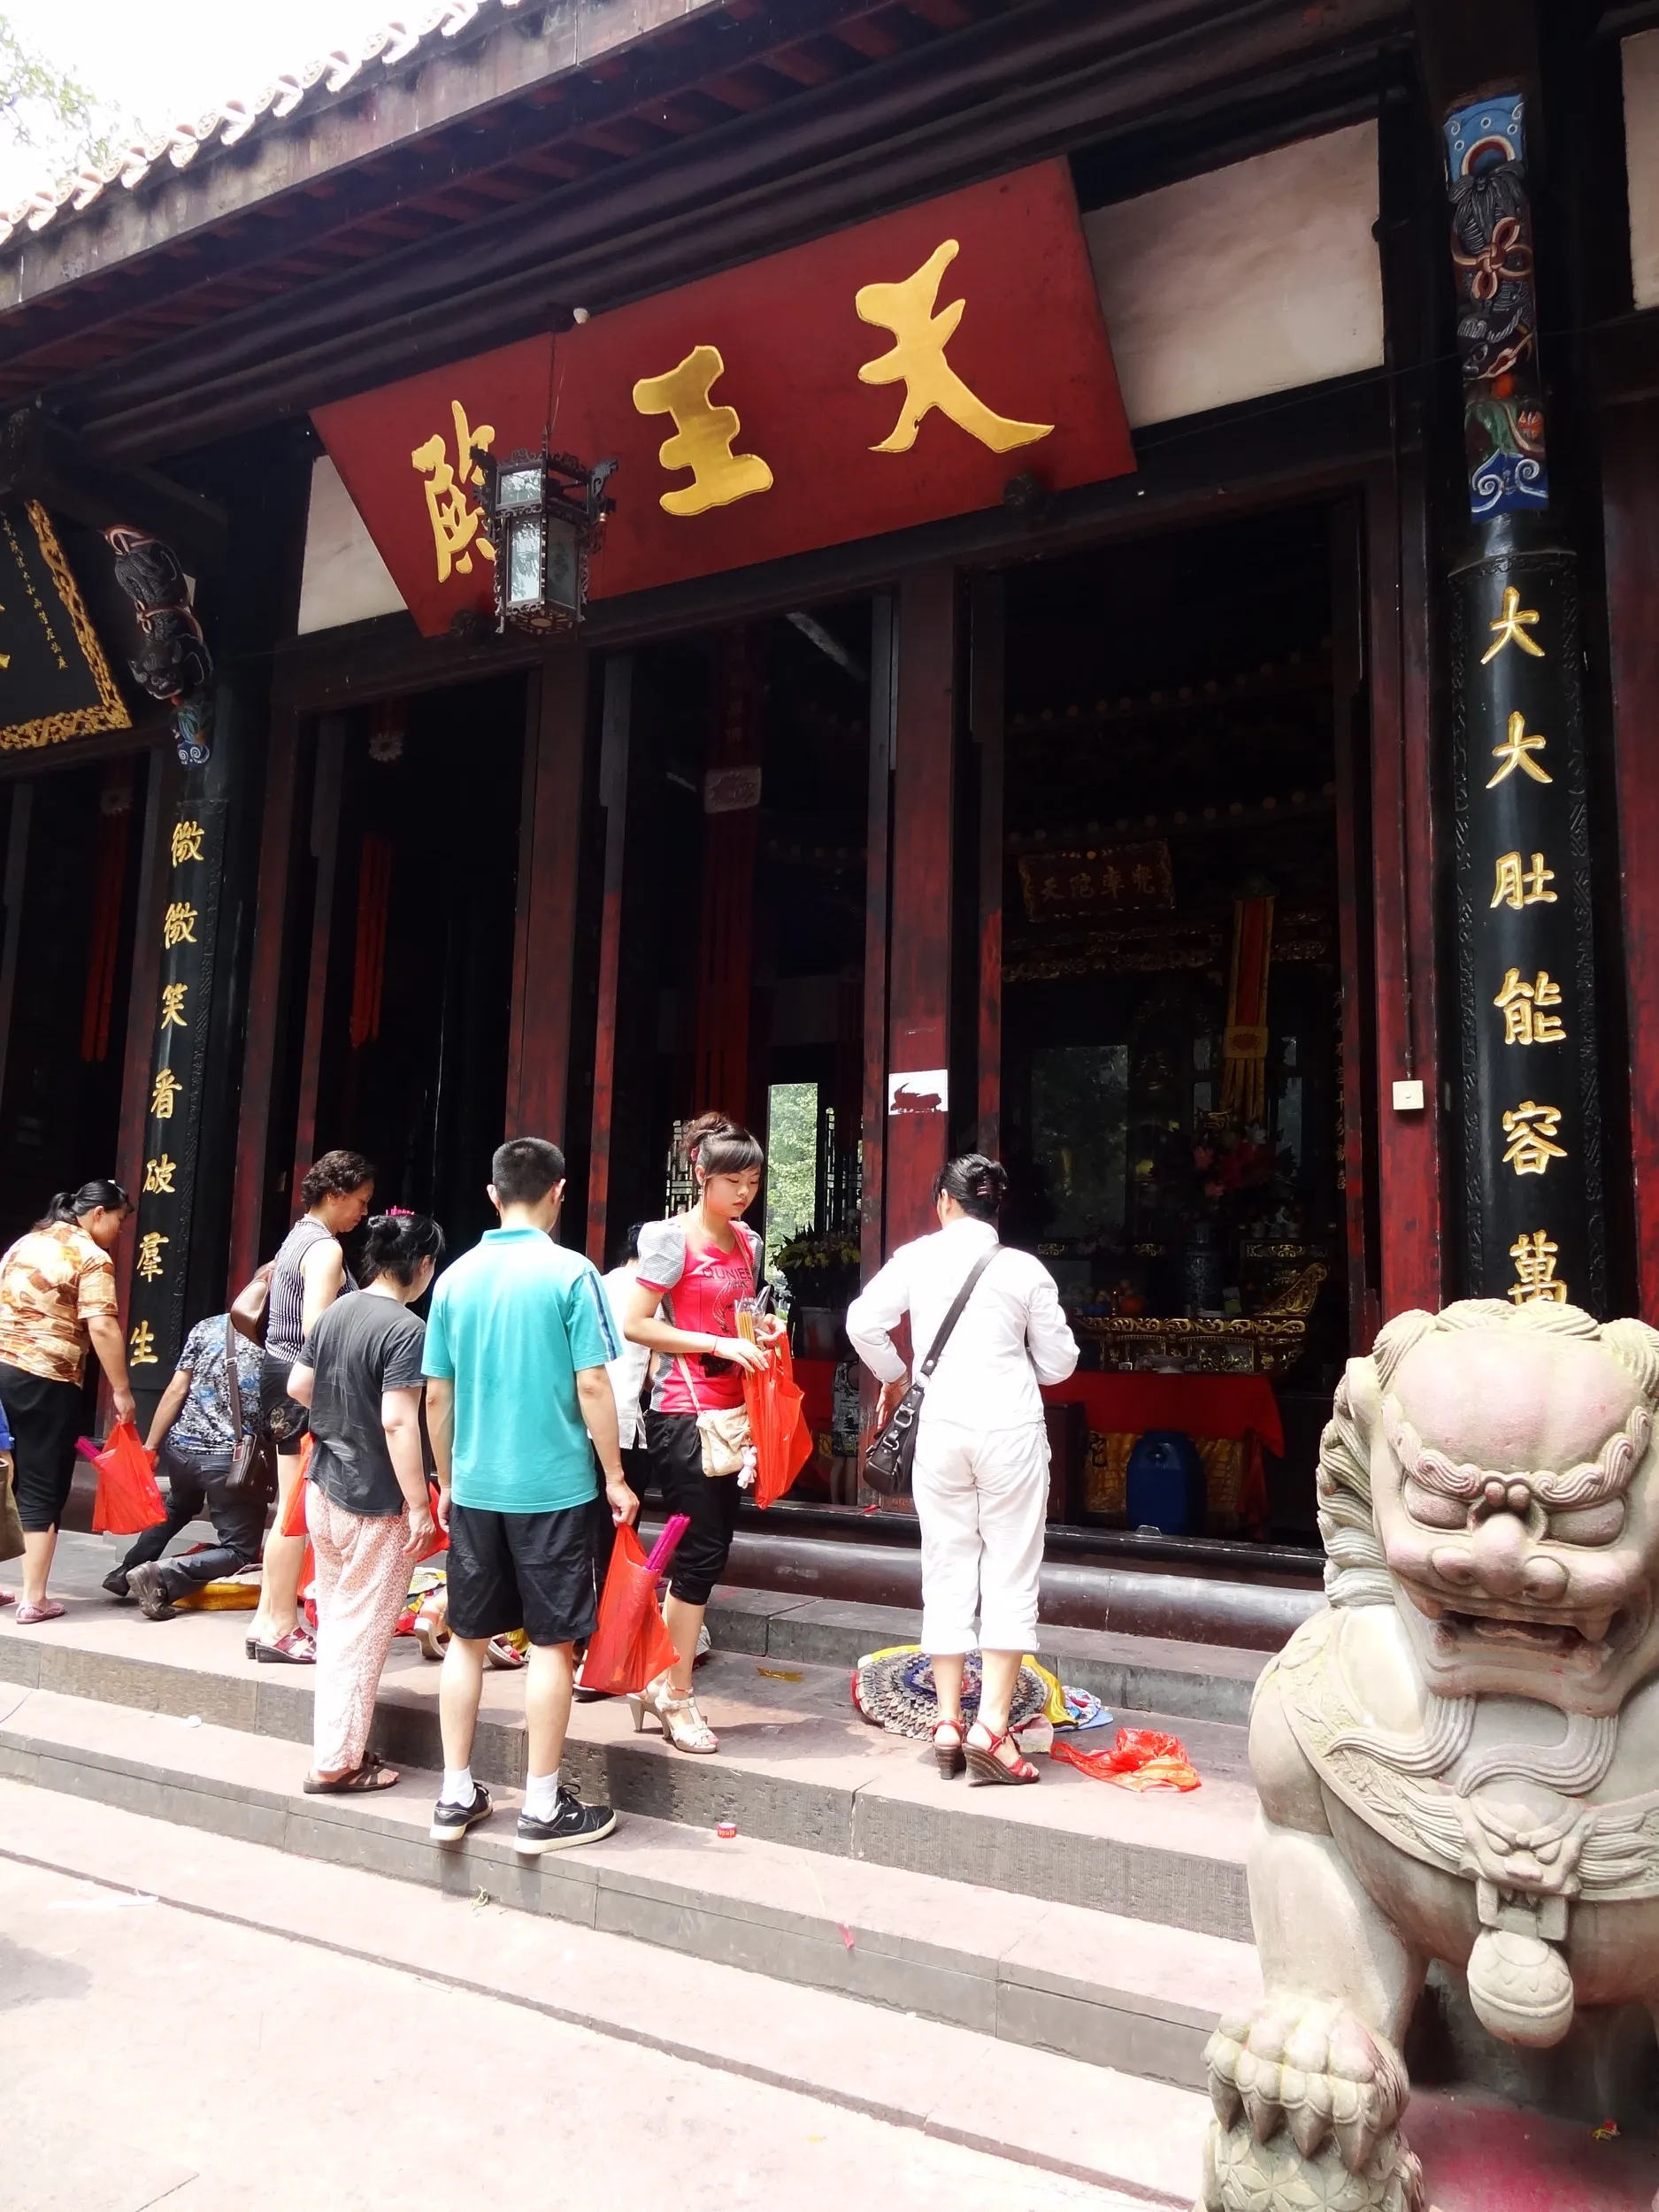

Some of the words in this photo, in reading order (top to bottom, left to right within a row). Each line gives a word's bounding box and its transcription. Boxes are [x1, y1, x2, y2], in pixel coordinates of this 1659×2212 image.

[1480, 586, 1567, 1305] 大大肚能容萬
